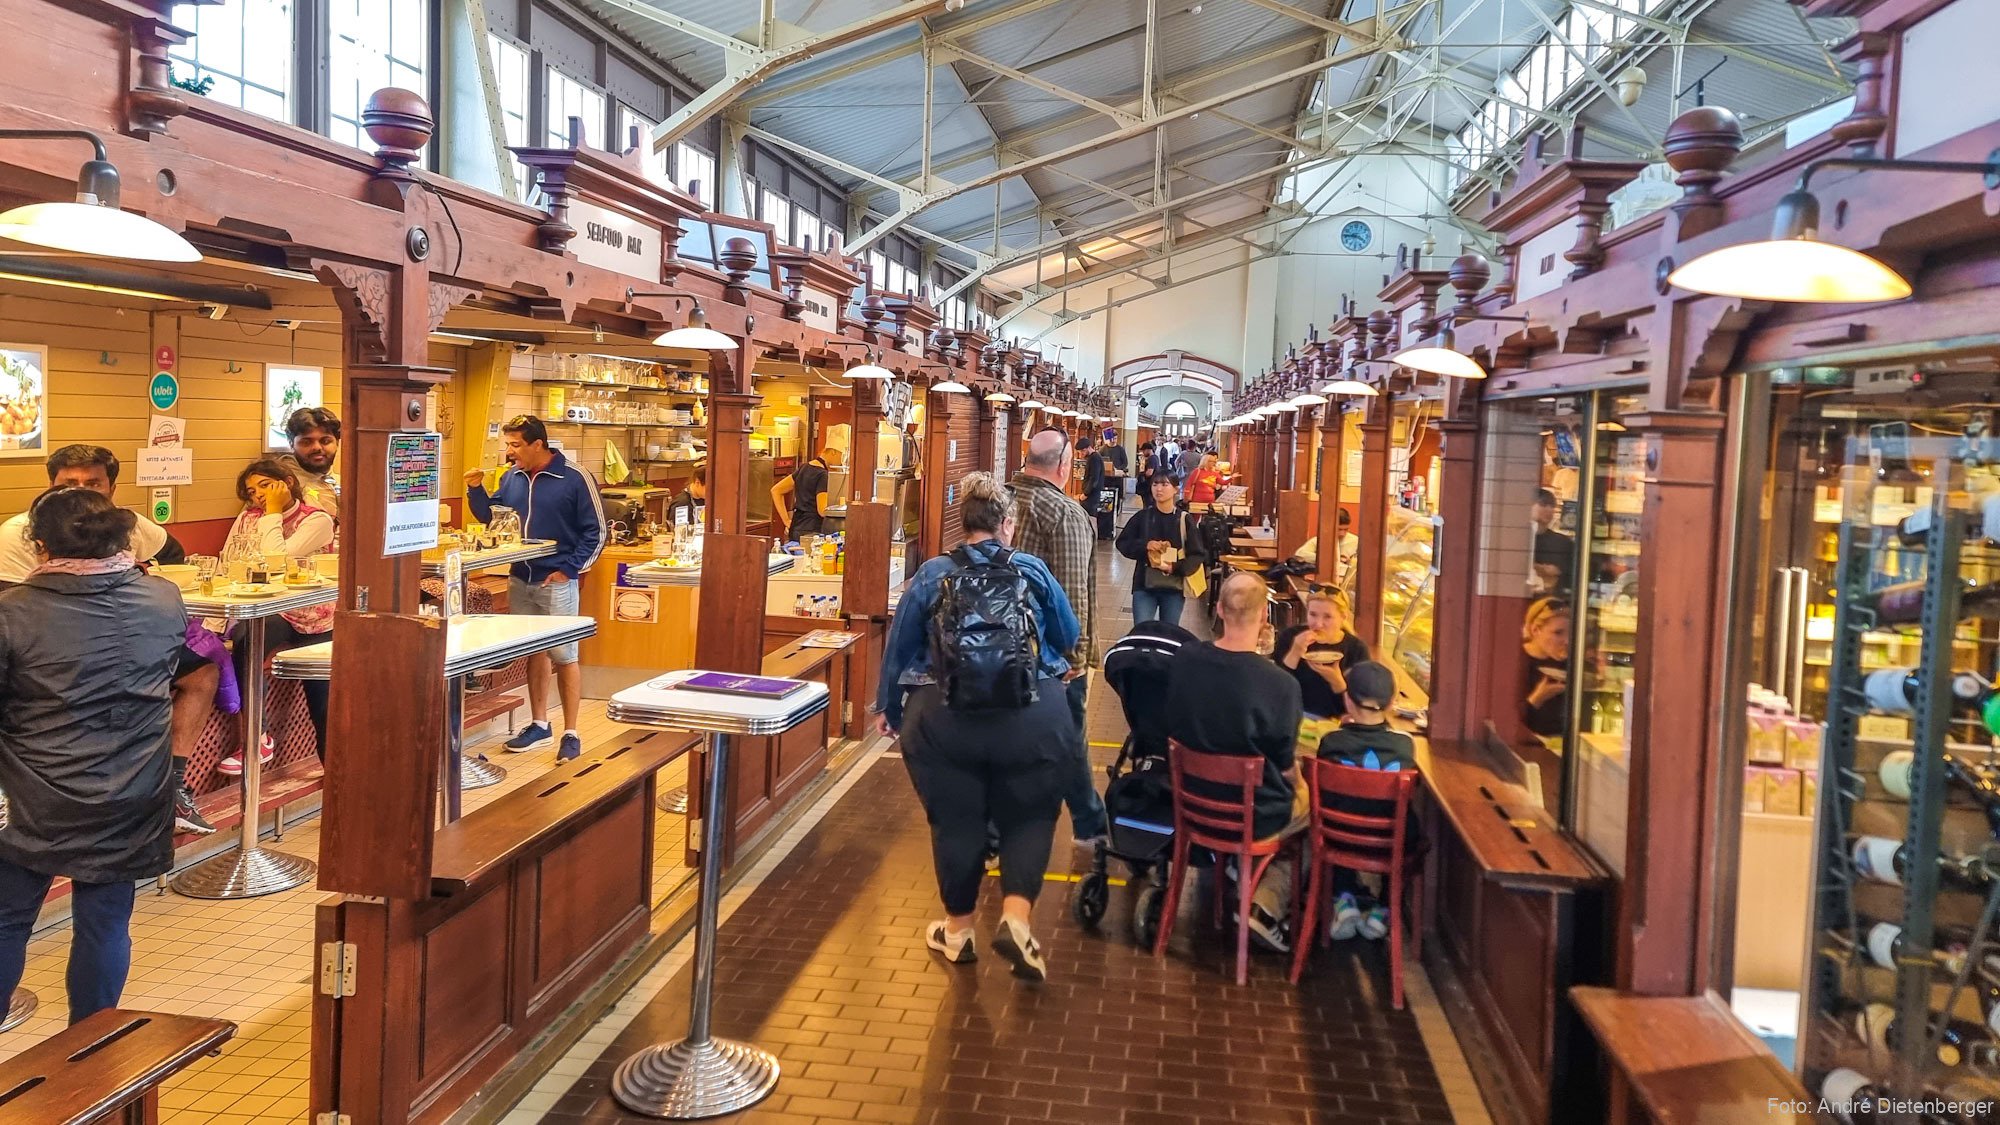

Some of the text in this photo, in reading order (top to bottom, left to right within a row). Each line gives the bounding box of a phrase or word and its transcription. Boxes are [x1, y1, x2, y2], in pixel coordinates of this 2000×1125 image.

[586, 221, 642, 256] SEAFOOD BAR
[154, 386, 173, 396] Wolt
